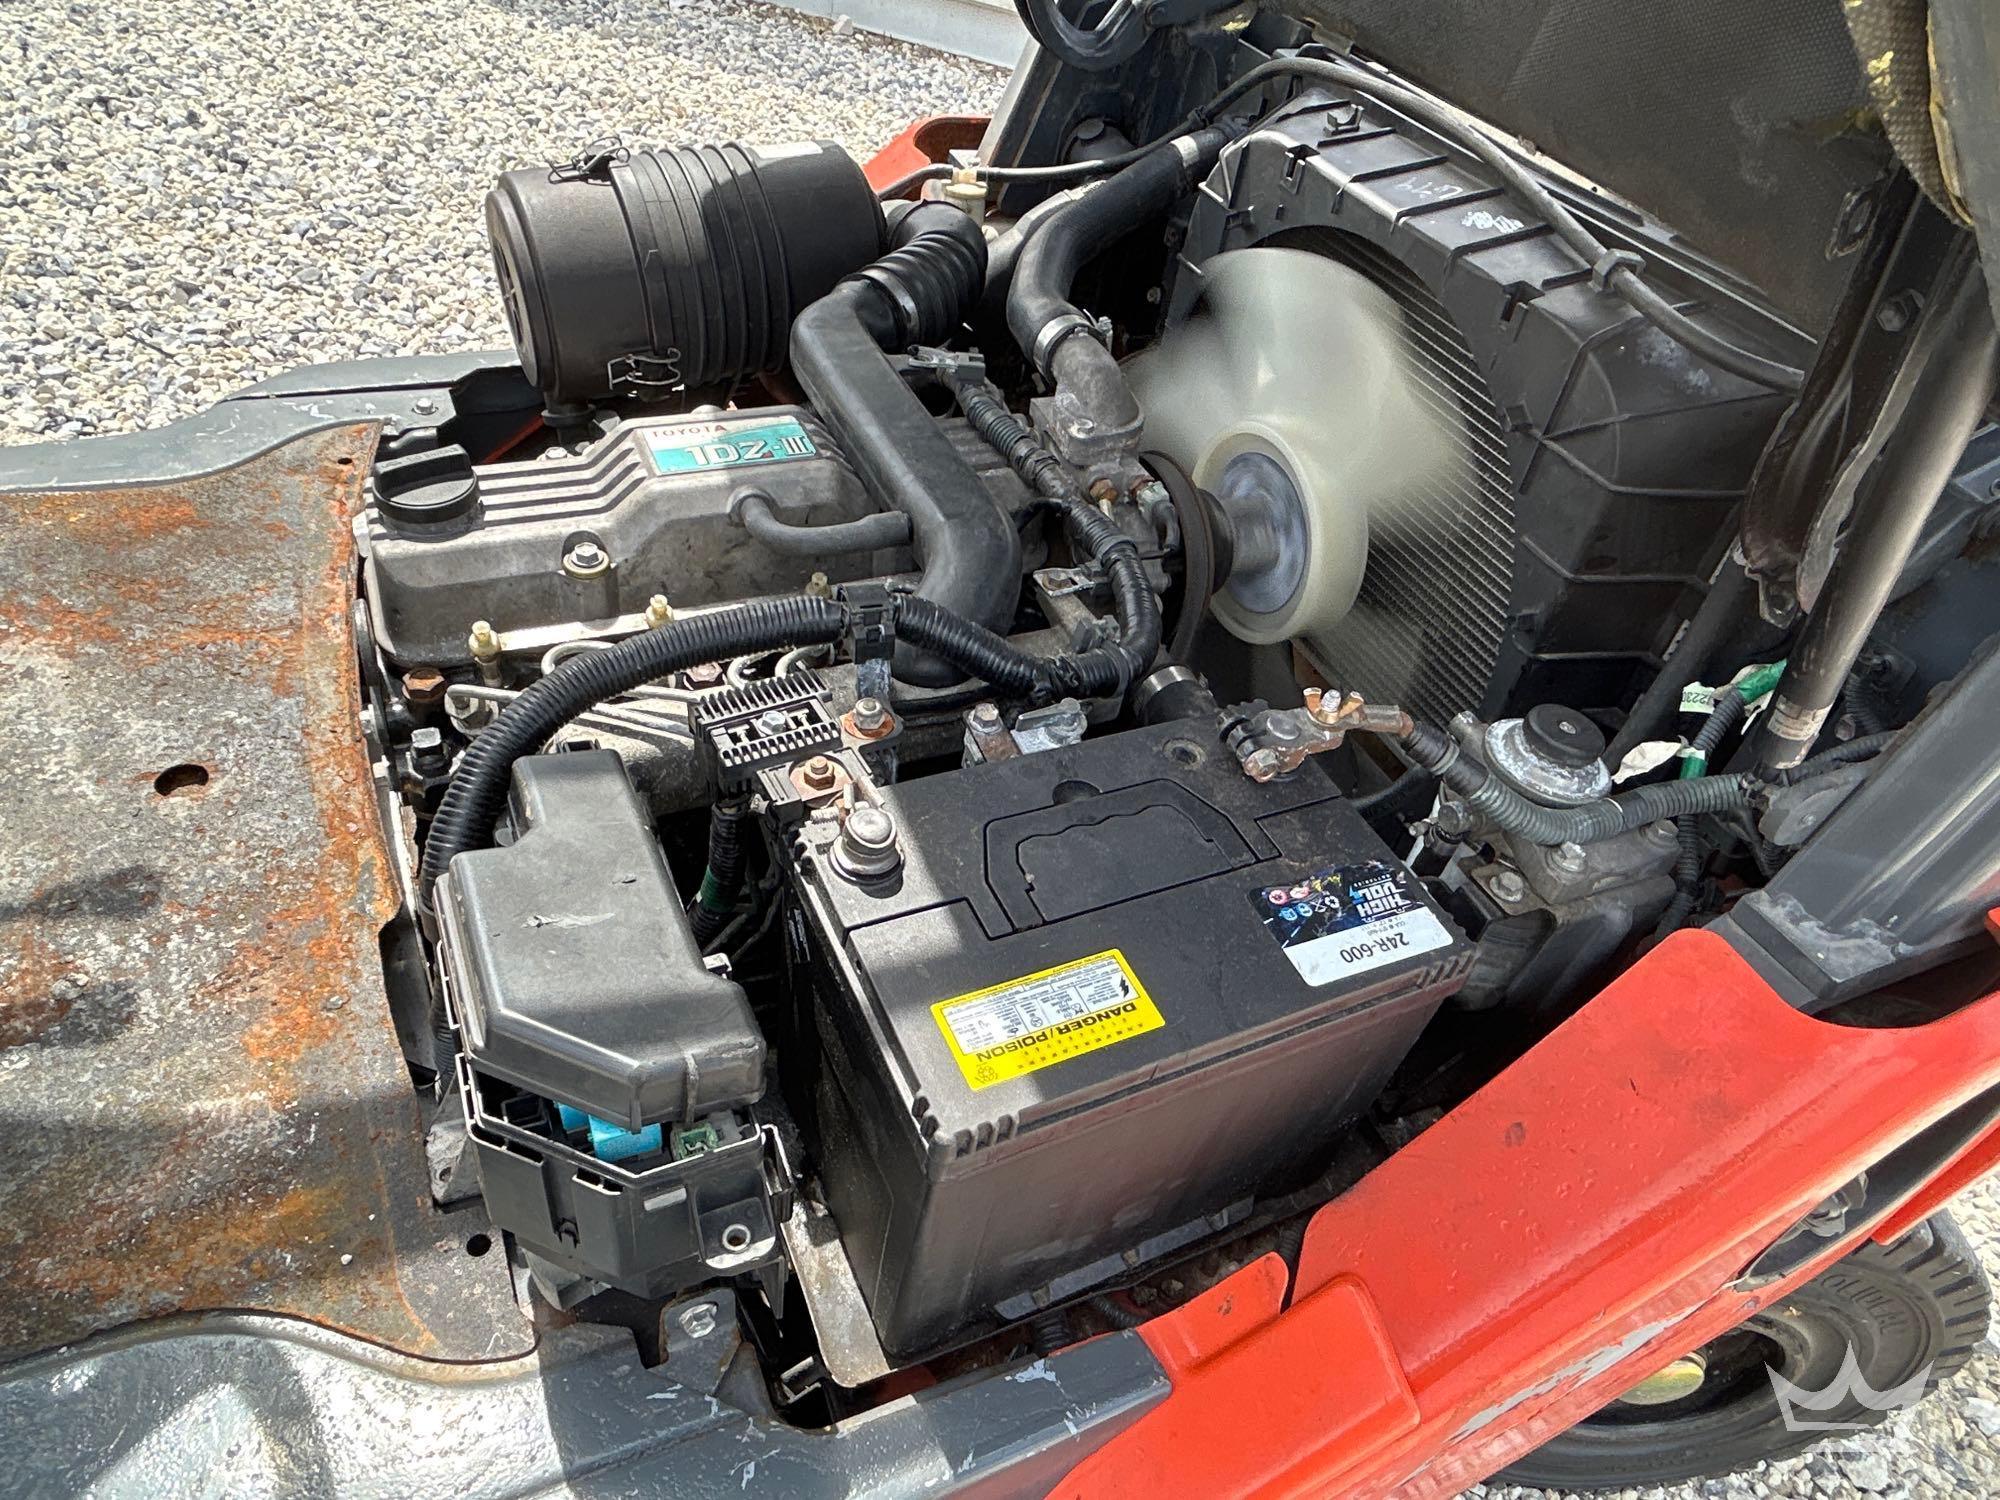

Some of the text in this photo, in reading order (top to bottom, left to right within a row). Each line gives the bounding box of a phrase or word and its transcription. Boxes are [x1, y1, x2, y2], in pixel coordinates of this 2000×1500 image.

[653, 424, 727, 438] TOYOTA
[1356, 893, 1406, 918] HIGH
[1339, 932, 1410, 964] 24R-600
